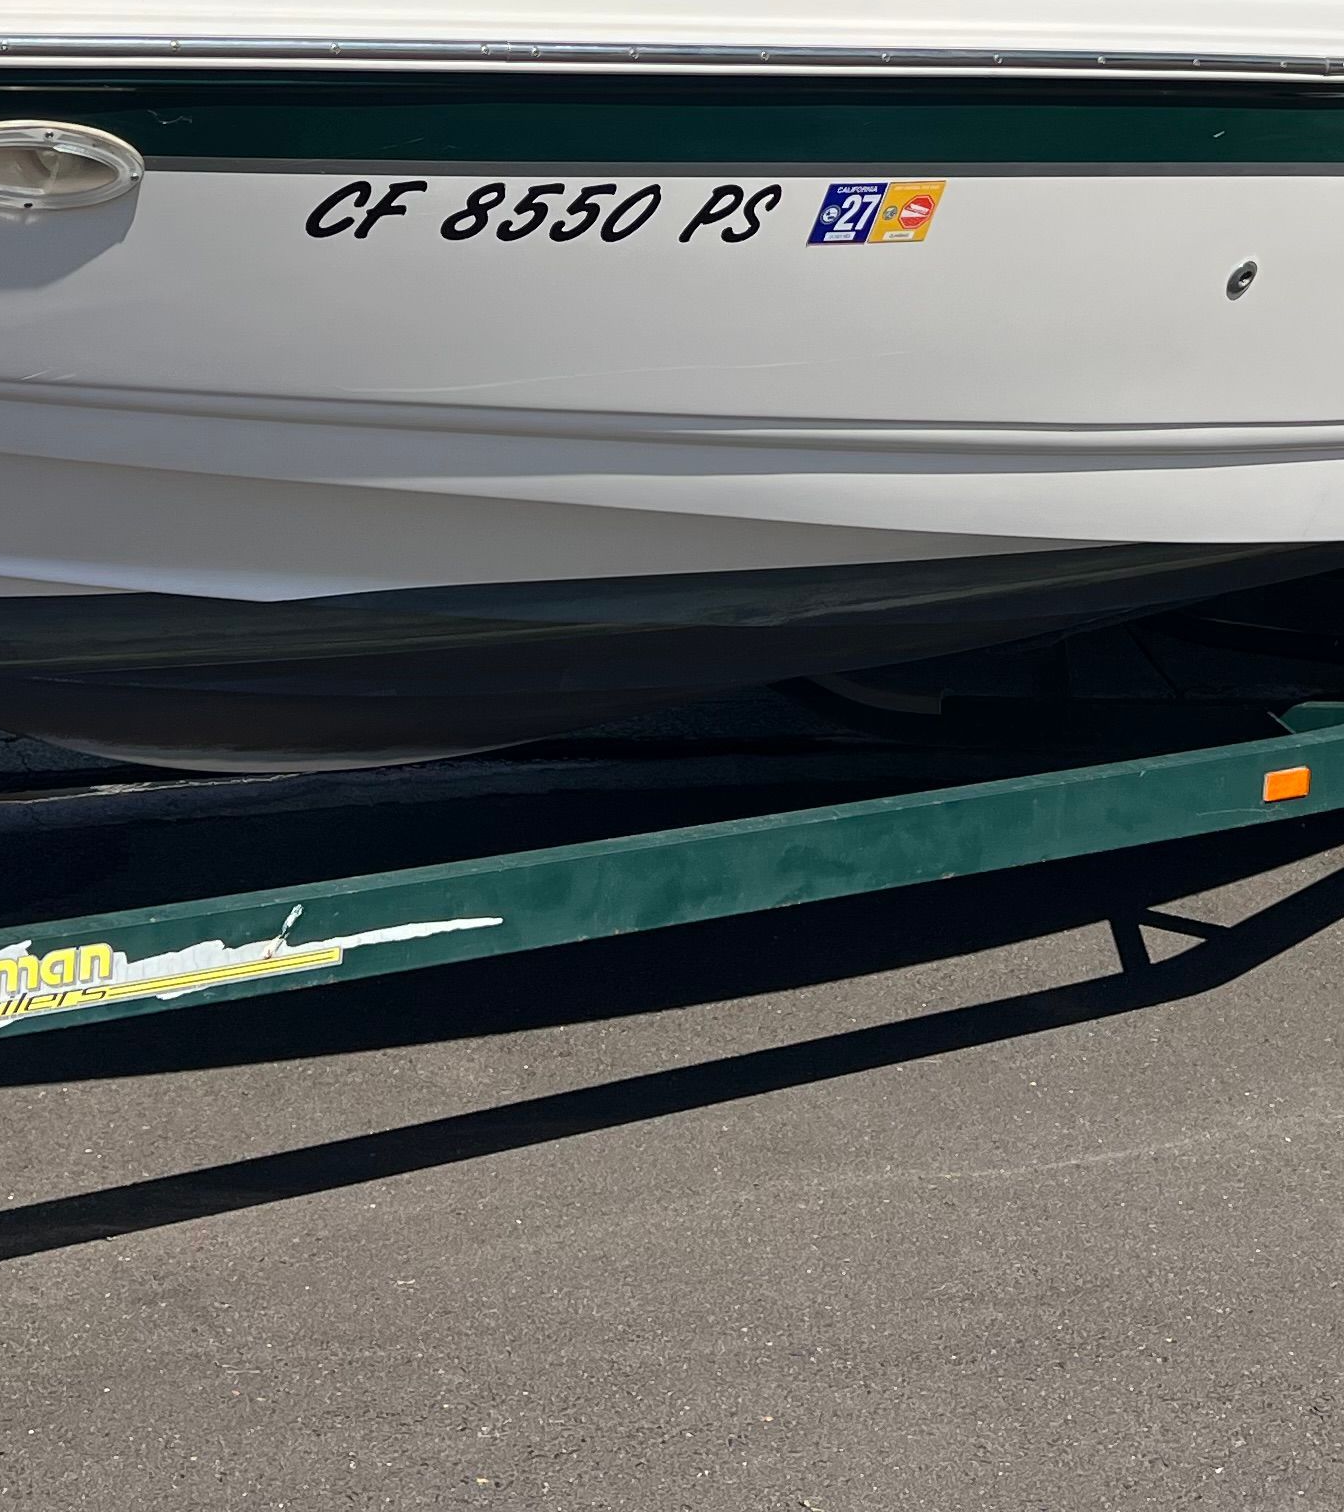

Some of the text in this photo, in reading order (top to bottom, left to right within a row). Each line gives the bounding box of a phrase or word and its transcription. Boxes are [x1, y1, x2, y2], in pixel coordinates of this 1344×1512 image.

[837, 185, 878, 194] CALIFORNIA
[306, 180, 782, 243] CF 8550 PS
[833, 194, 882, 231] 27
